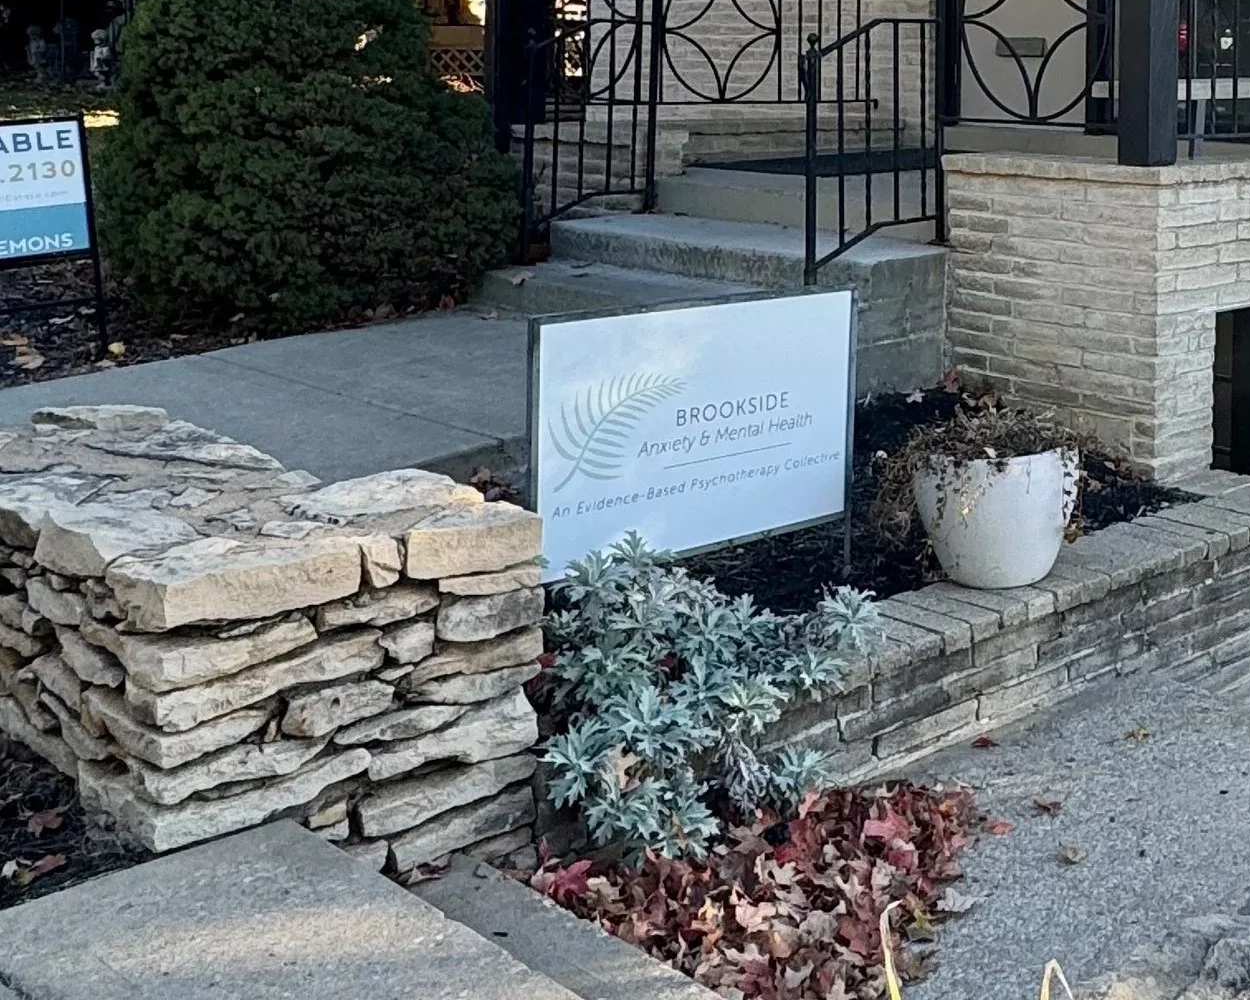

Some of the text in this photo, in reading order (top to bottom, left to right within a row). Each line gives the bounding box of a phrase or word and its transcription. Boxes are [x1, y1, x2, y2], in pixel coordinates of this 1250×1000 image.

[676, 391, 790, 427] BROOKSIDE
[637, 411, 813, 459] Anxiety & Mental Health
[552, 450, 841, 519] An Evidence-Based Psychotherapy Collective
